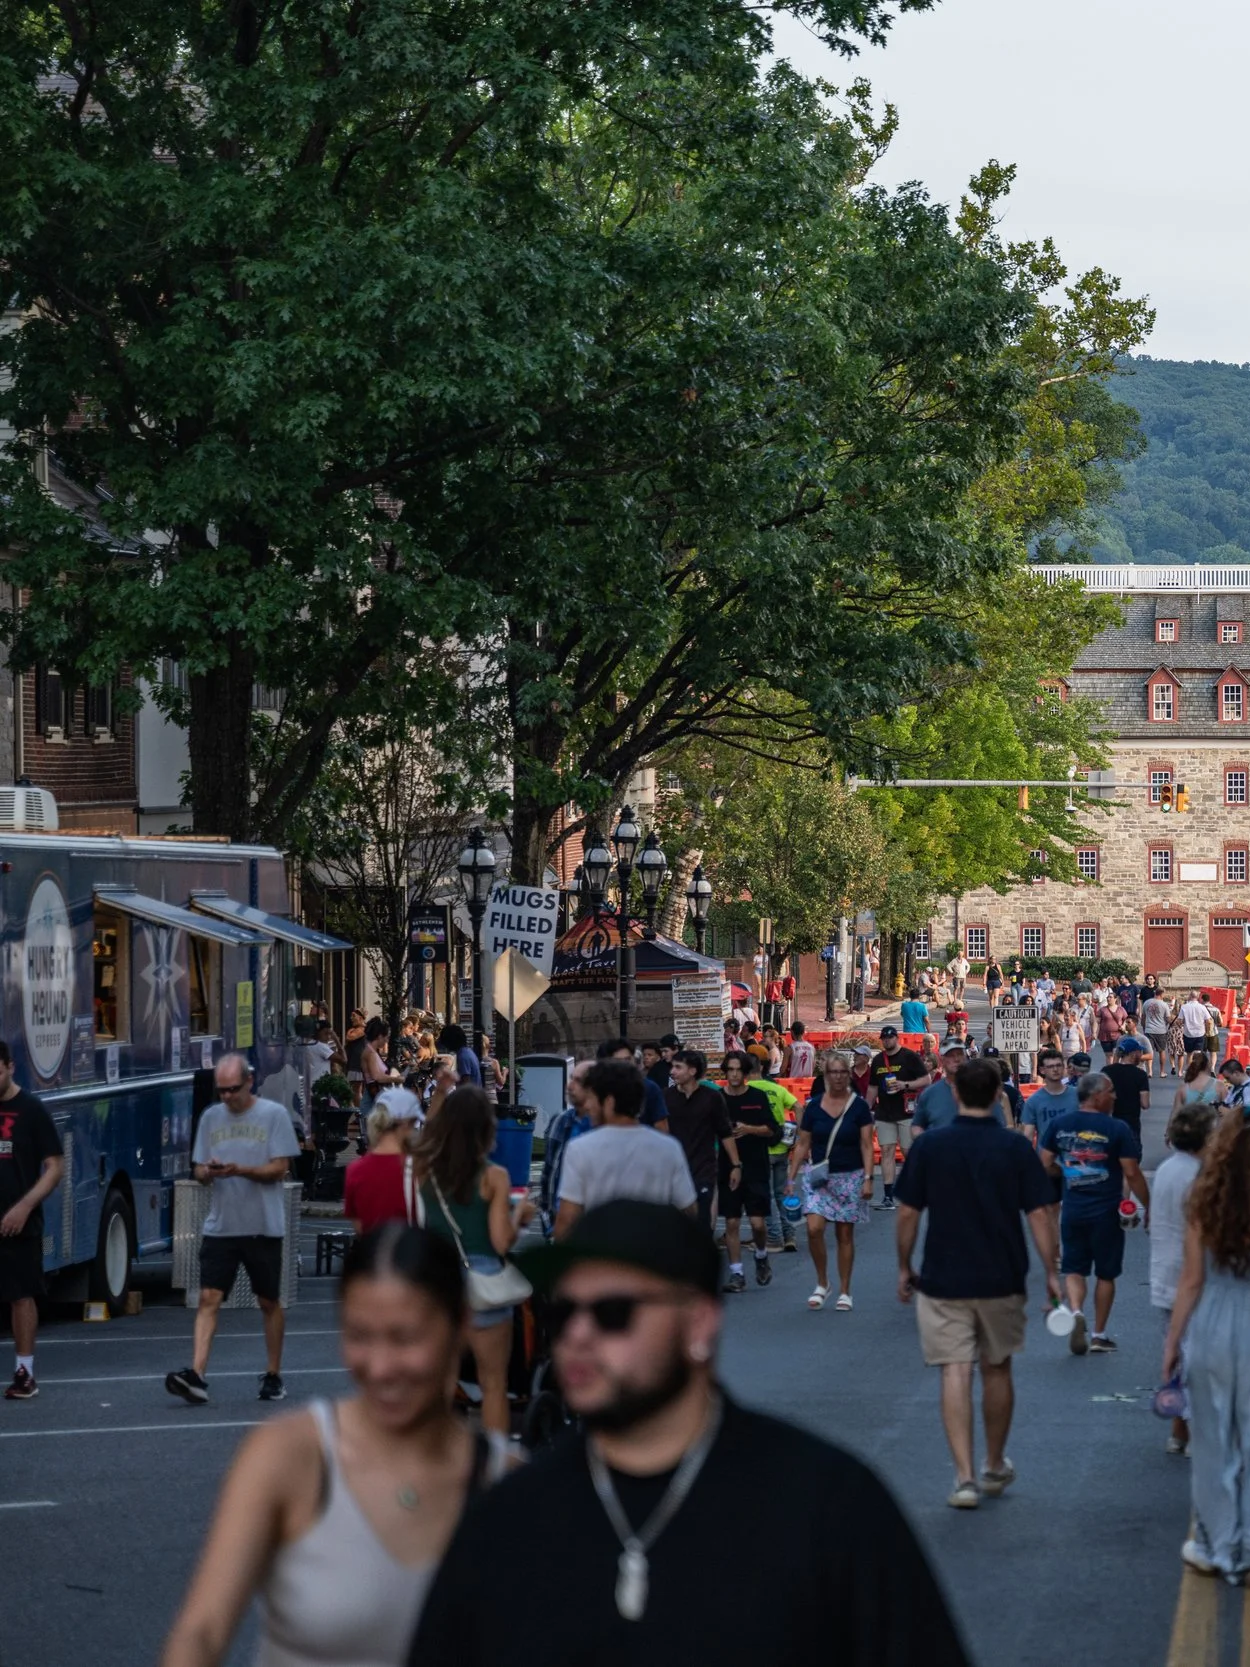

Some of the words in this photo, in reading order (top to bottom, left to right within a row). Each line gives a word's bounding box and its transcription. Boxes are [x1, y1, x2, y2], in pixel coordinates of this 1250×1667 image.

[492, 887, 557, 911] MUGS
[489, 911, 553, 935] FILLED
[492, 936, 545, 959] HERE
[27, 946, 70, 981] HUNGRY
[587, 959, 616, 969] Tave
[31, 991, 67, 1026] HOUND
[1000, 1009, 1031, 1019] CAUTION!
[1001, 1019, 1031, 1029] VEHICLE
[35, 1033, 61, 1049] EXPRESS
[1002, 1031, 1031, 1040] TRAFFIC
[1004, 1041, 1029, 1050] AHEAD
